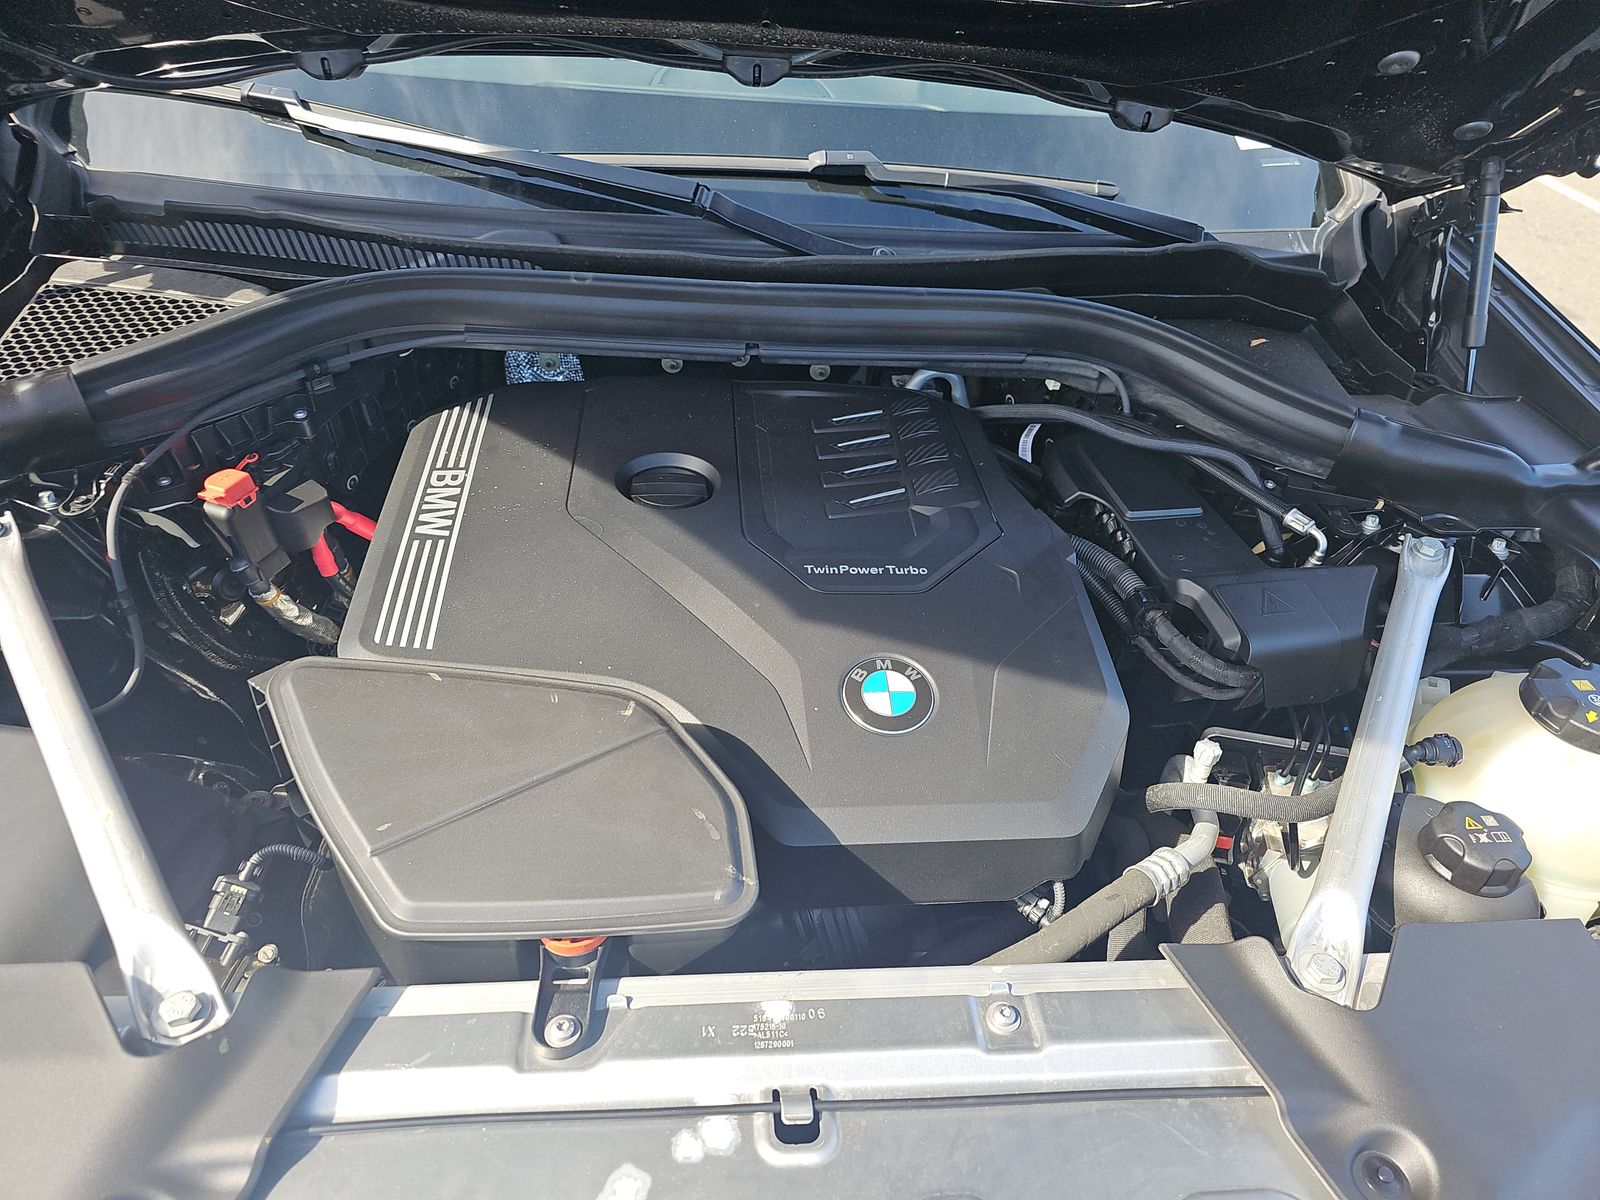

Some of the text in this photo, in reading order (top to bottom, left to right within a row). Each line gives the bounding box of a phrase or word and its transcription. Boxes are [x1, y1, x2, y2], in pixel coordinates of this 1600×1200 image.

[414, 469, 467, 537] BMW
[804, 564, 928, 575] TwinPower Turbo
[850, 659, 922, 683] BMW
